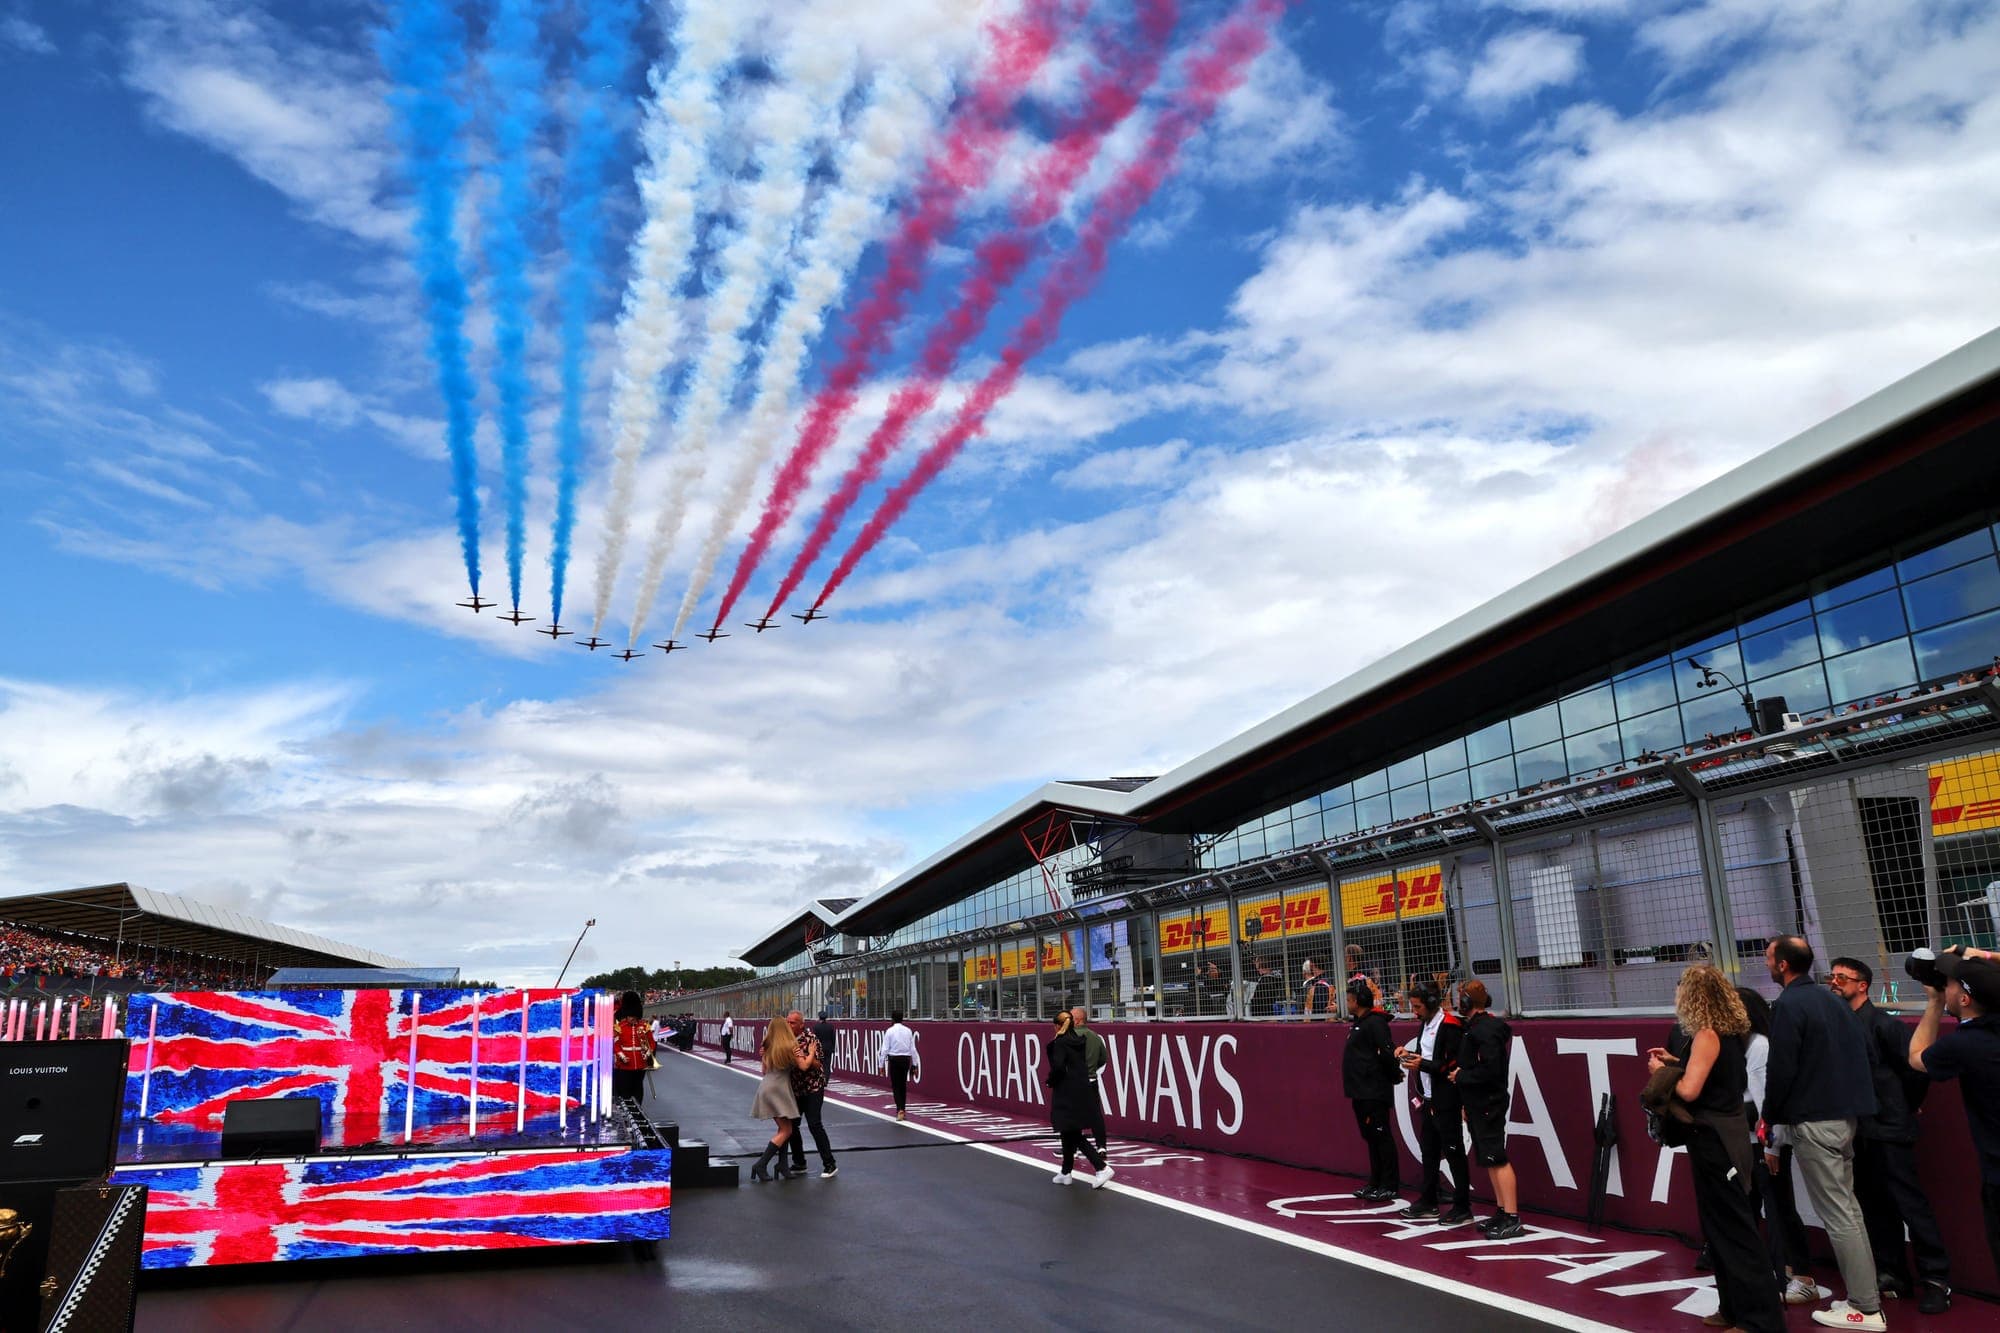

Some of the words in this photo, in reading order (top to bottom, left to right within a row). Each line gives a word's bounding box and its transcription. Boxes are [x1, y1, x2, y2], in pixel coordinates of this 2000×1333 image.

[1376, 873, 1445, 915] DH
[1260, 897, 1328, 932] DHL
[1166, 918, 1217, 947] DHL
[9, 1067, 33, 1075] LOUIS
[35, 1066, 69, 1074] VUITTON
[830, 1028, 860, 1074] ATAR
[862, 1029, 921, 1084] AIRS
[957, 1031, 1045, 1105] QATAR
[1096, 1034, 1244, 1135] WAYS
[882, 1102, 1013, 1128] QATAR
